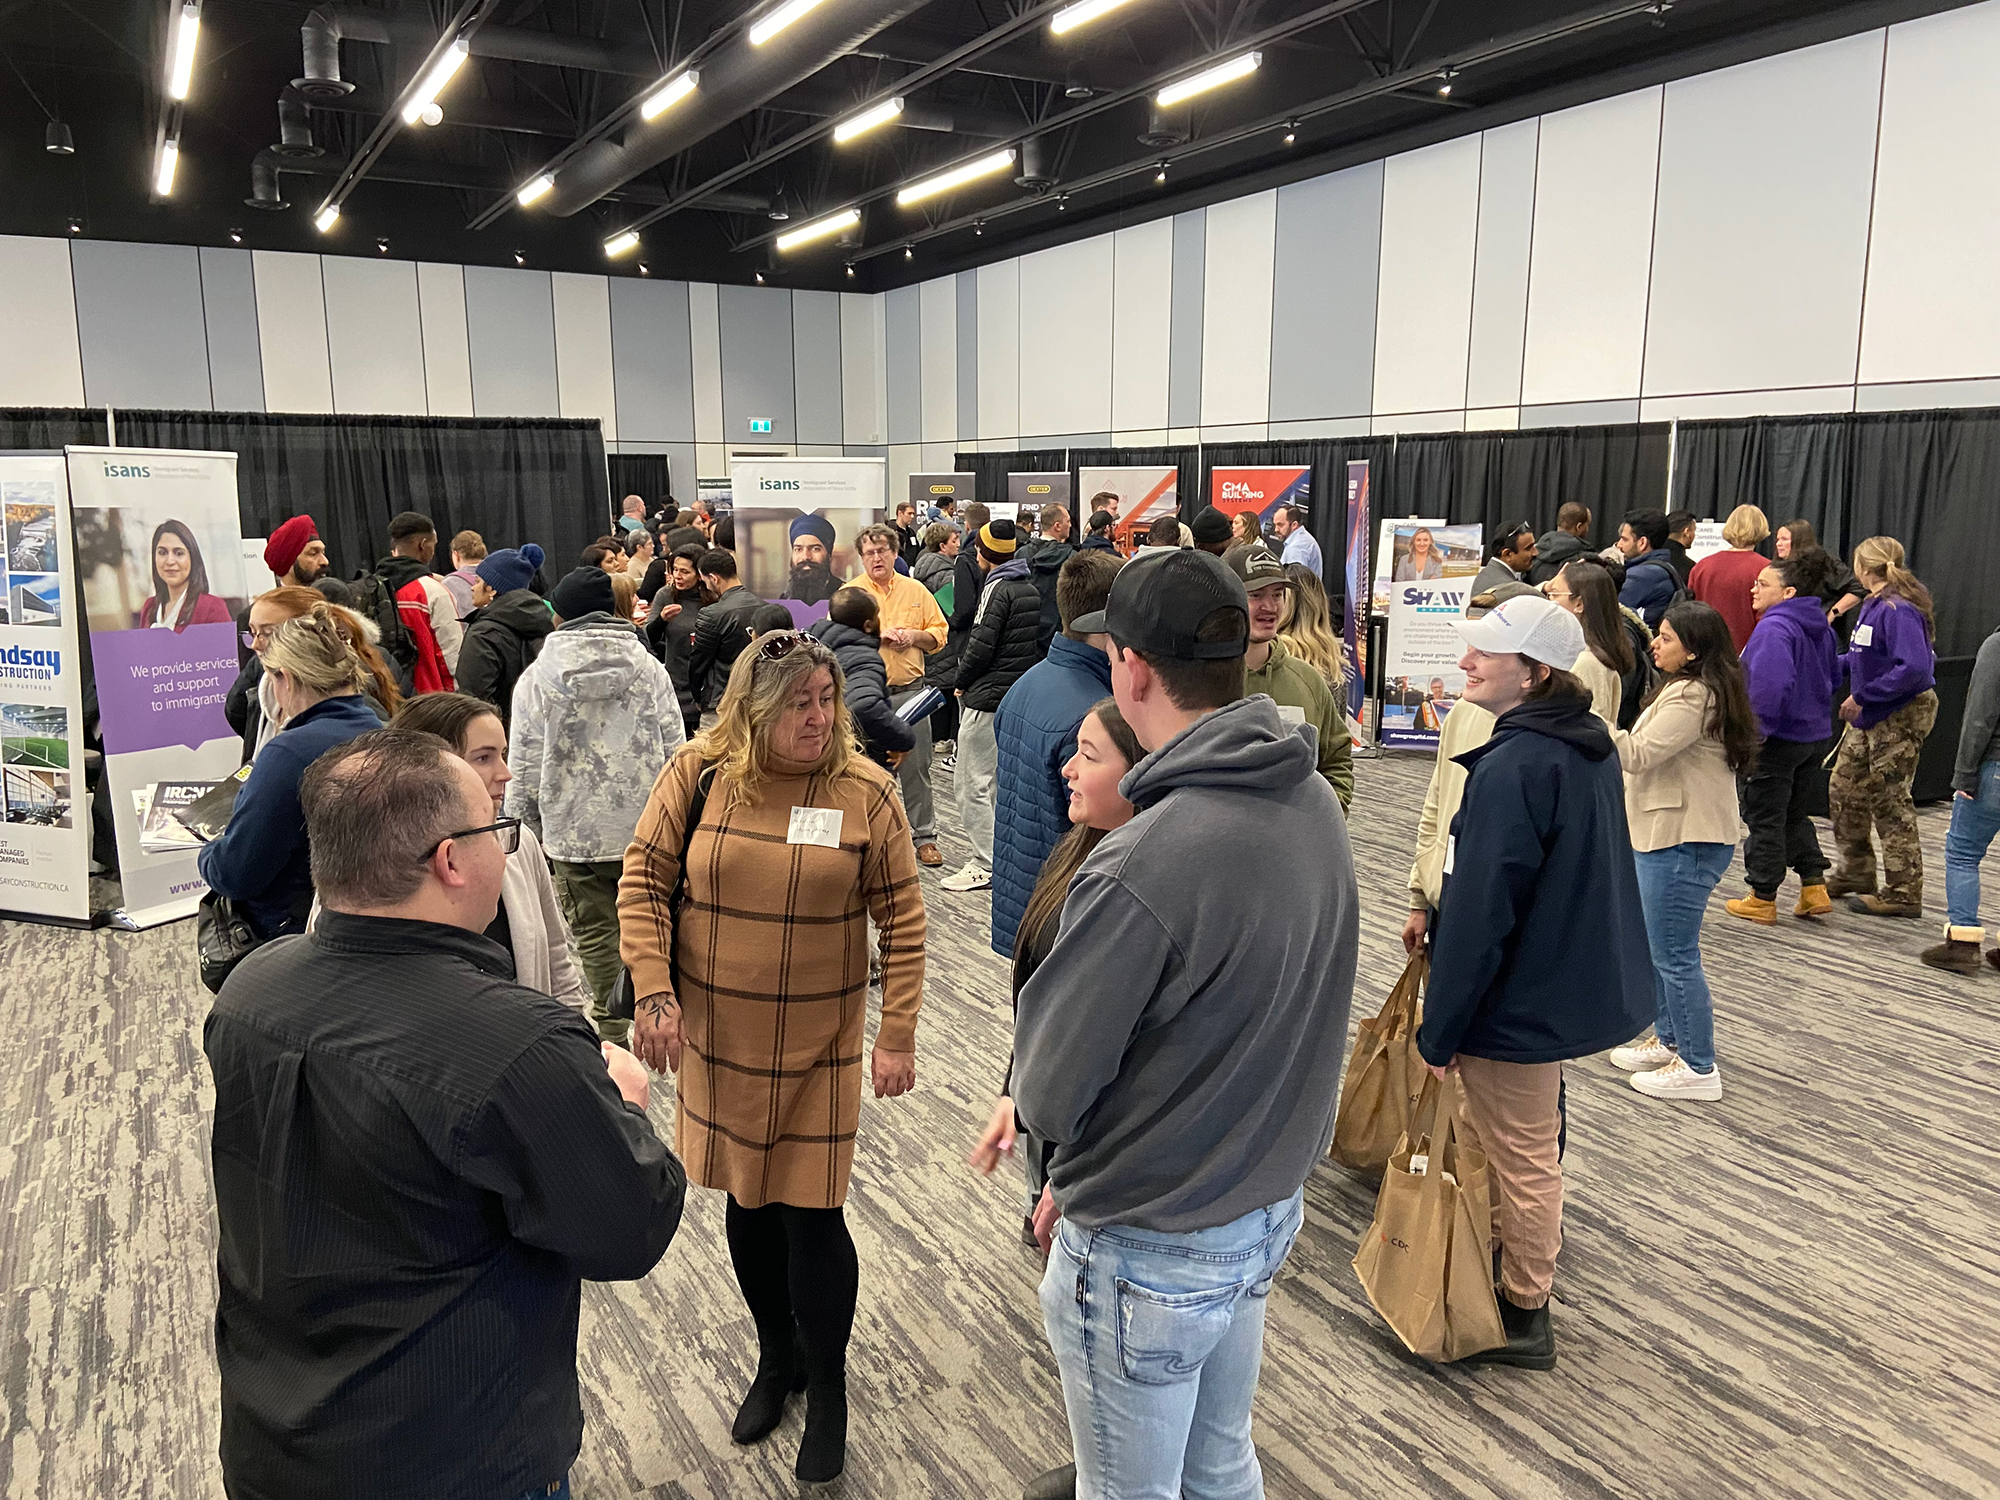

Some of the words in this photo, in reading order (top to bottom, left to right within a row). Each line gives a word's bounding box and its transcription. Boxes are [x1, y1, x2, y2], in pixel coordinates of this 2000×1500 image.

[103, 461, 151, 478] isans
[760, 476, 800, 490] isans
[1222, 481, 1250, 492] CMA
[1402, 587, 1465, 605] SHAW
[130, 665, 149, 678] We
[151, 659, 192, 679] provide
[195, 657, 239, 672] services
[153, 678, 174, 694] and
[176, 676, 220, 692] support
[151, 701, 163, 712] to
[165, 693, 227, 710] immigrants
